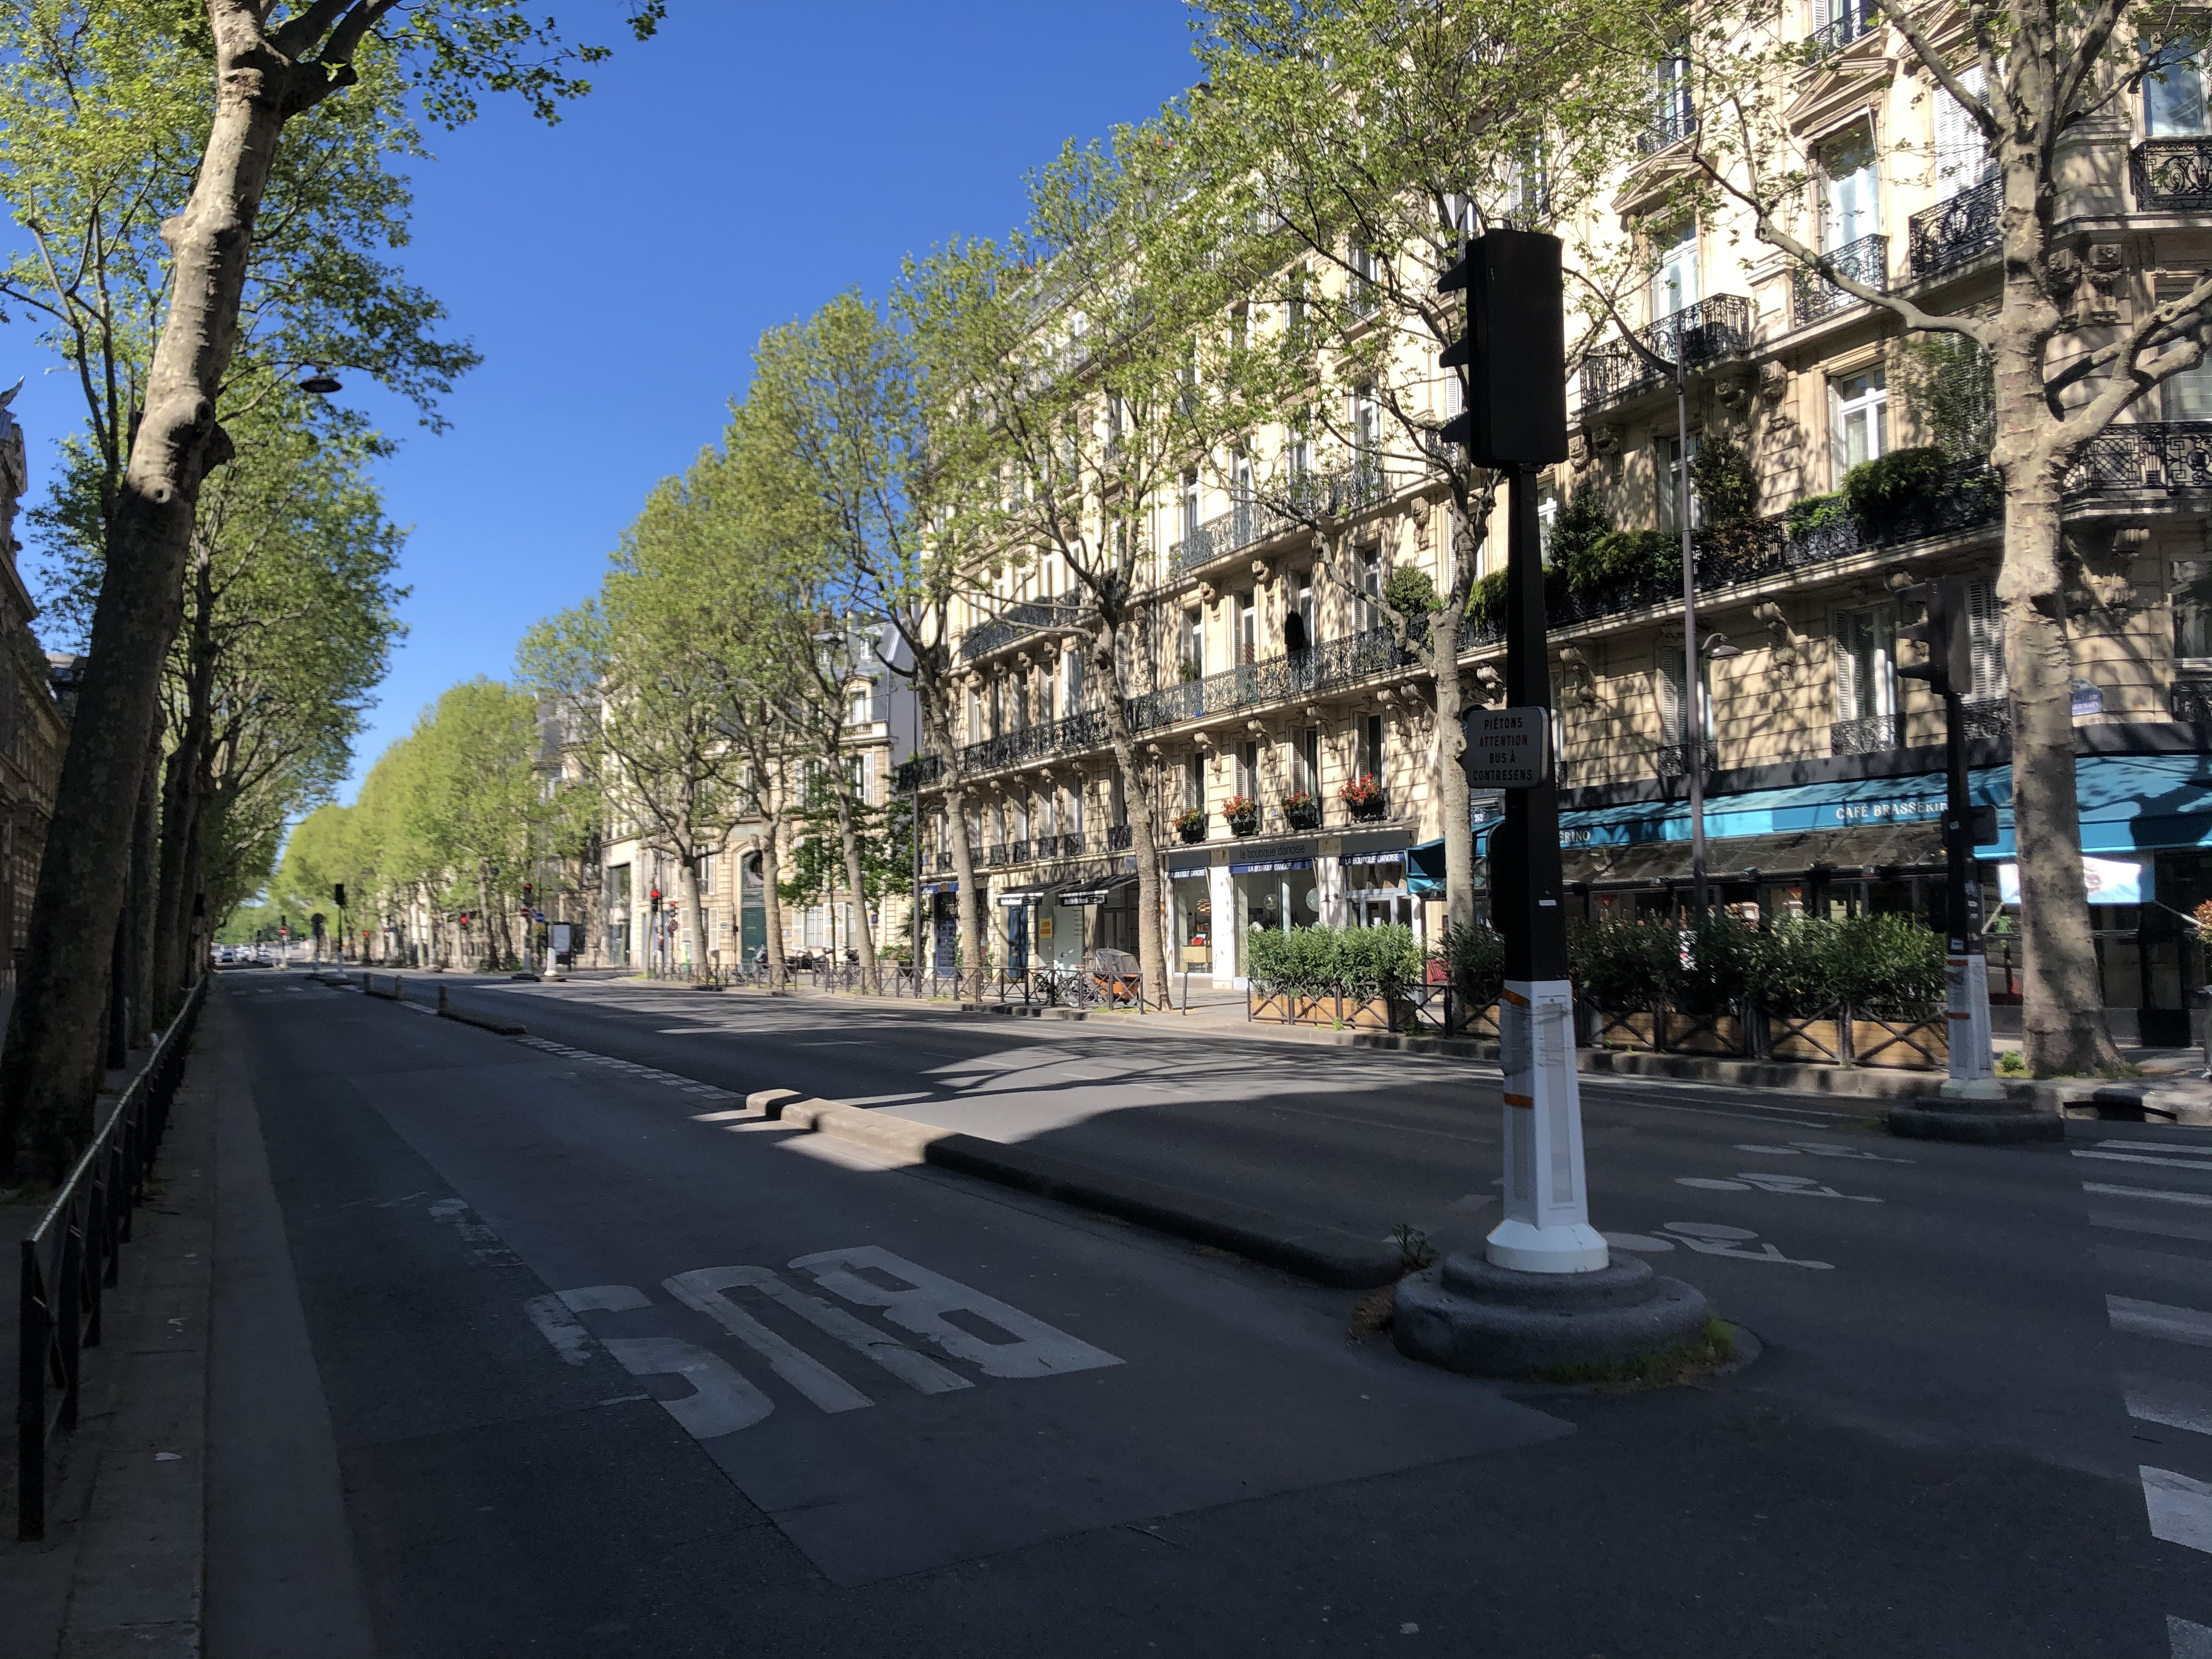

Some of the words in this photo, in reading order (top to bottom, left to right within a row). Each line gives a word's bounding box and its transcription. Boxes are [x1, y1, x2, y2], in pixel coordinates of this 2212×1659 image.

[1484, 716, 1523, 730] PIÉTONS
[1479, 734, 1528, 747] ATTENTION
[1489, 753, 1506, 764] BUS
[1510, 749, 1516, 764] À
[1473, 769, 1532, 781] CONTRESENS
[1836, 804, 1869, 820] CAFÉ
[1240, 849, 1245, 859] la
[1248, 848, 1275, 860] boutique
[1278, 844, 1305, 856] danoise
[1353, 855, 1376, 864] BOUTIQUE
[1377, 853, 1399, 862] DANOISE
[1254, 864, 1272, 872] BOUTIQUE
[1274, 863, 1291, 871] DANOISE
[525, 1245, 1127, 1438] BUS
